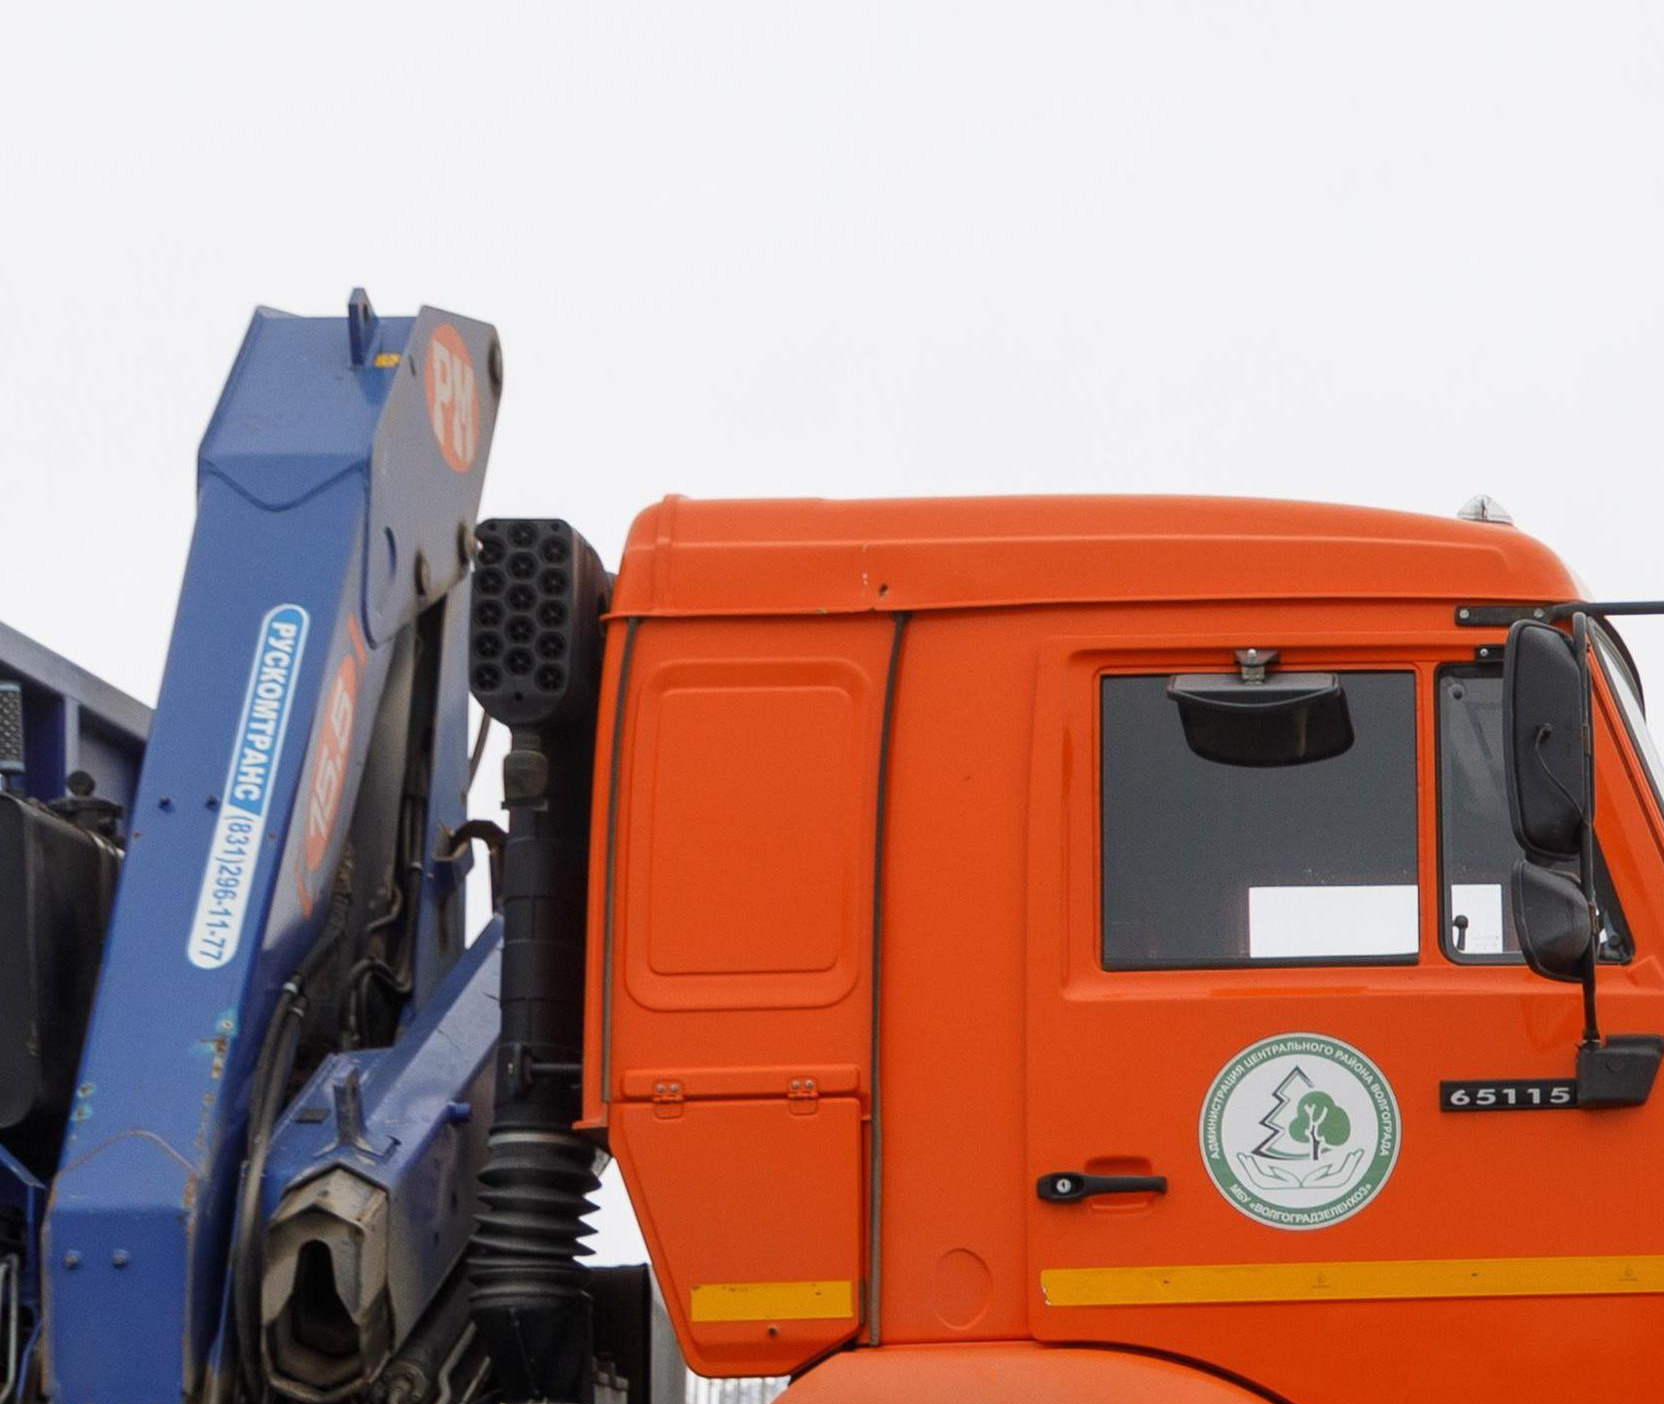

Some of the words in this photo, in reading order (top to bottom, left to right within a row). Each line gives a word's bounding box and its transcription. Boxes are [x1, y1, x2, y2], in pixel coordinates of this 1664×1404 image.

[432, 339, 475, 465] PM
[234, 620, 298, 801] РУСКОМТРАНС
[199, 813, 253, 962] (831)296-11-77
[1207, 1064, 1245, 1159] АДМИНИСТРАЦИЯ
[1243, 1041, 1334, 1067] ЦЕНТРАЛЬНОГО
[1334, 1051, 1373, 1084] РАЙОНА
[1370, 1083, 1394, 1156] ВОЛГОГРАДА
[1450, 1087, 1570, 1105] 65115
[1229, 1183, 1252, 1203] МБУ
[1250, 1184, 1372, 1222] «ВОЛГОГРАДЗЕЛЕНХОЗ»
